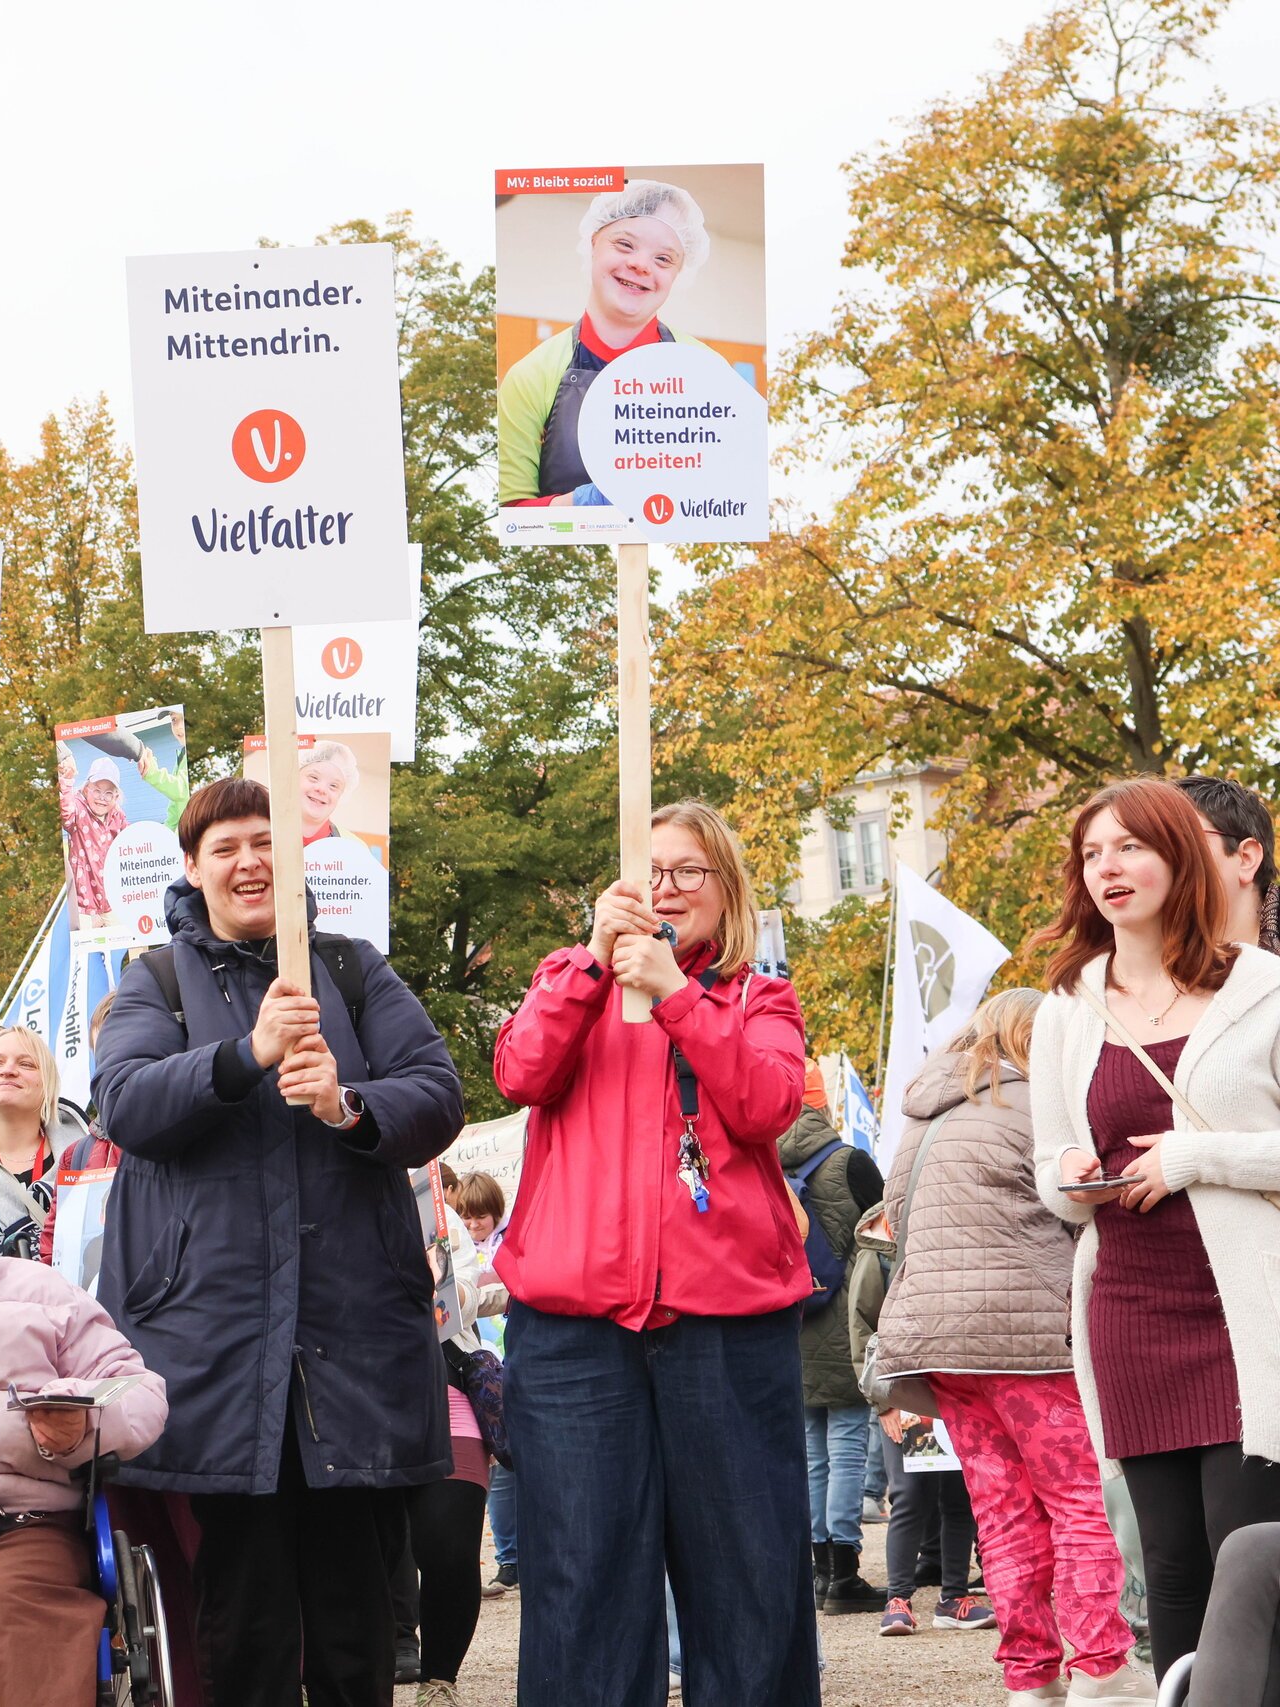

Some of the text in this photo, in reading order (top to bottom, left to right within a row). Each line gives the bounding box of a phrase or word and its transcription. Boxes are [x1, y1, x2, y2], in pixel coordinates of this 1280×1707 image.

[506, 174, 614, 188] MV: Bleibt sozial!
[164, 279, 362, 314] Miteinander.
[167, 326, 340, 361] Mittendrin.
[613, 377, 684, 395] Ich will
[614, 401, 736, 420] Miteinander.
[614, 426, 722, 445] Mittendrin.
[250, 419, 292, 473] V.
[614, 452, 702, 470] arbeiten!
[650, 497, 747, 521] V. Vielfalter
[191, 504, 354, 555] Vielfalter
[331, 642, 355, 674] V.
[295, 691, 386, 721] Vielfalter
[118, 842, 152, 857] Ich will
[119, 855, 179, 872] Miteinander.
[304, 860, 343, 872] Ich will
[121, 871, 173, 887] Mittendrin.
[304, 875, 372, 886] Miteinander.
[122, 888, 159, 905] spielen!
[314, 890, 363, 900] ittendrin.
[432, 1174, 440, 1201] Bleibt
[436, 1202, 445, 1231] sozial!
